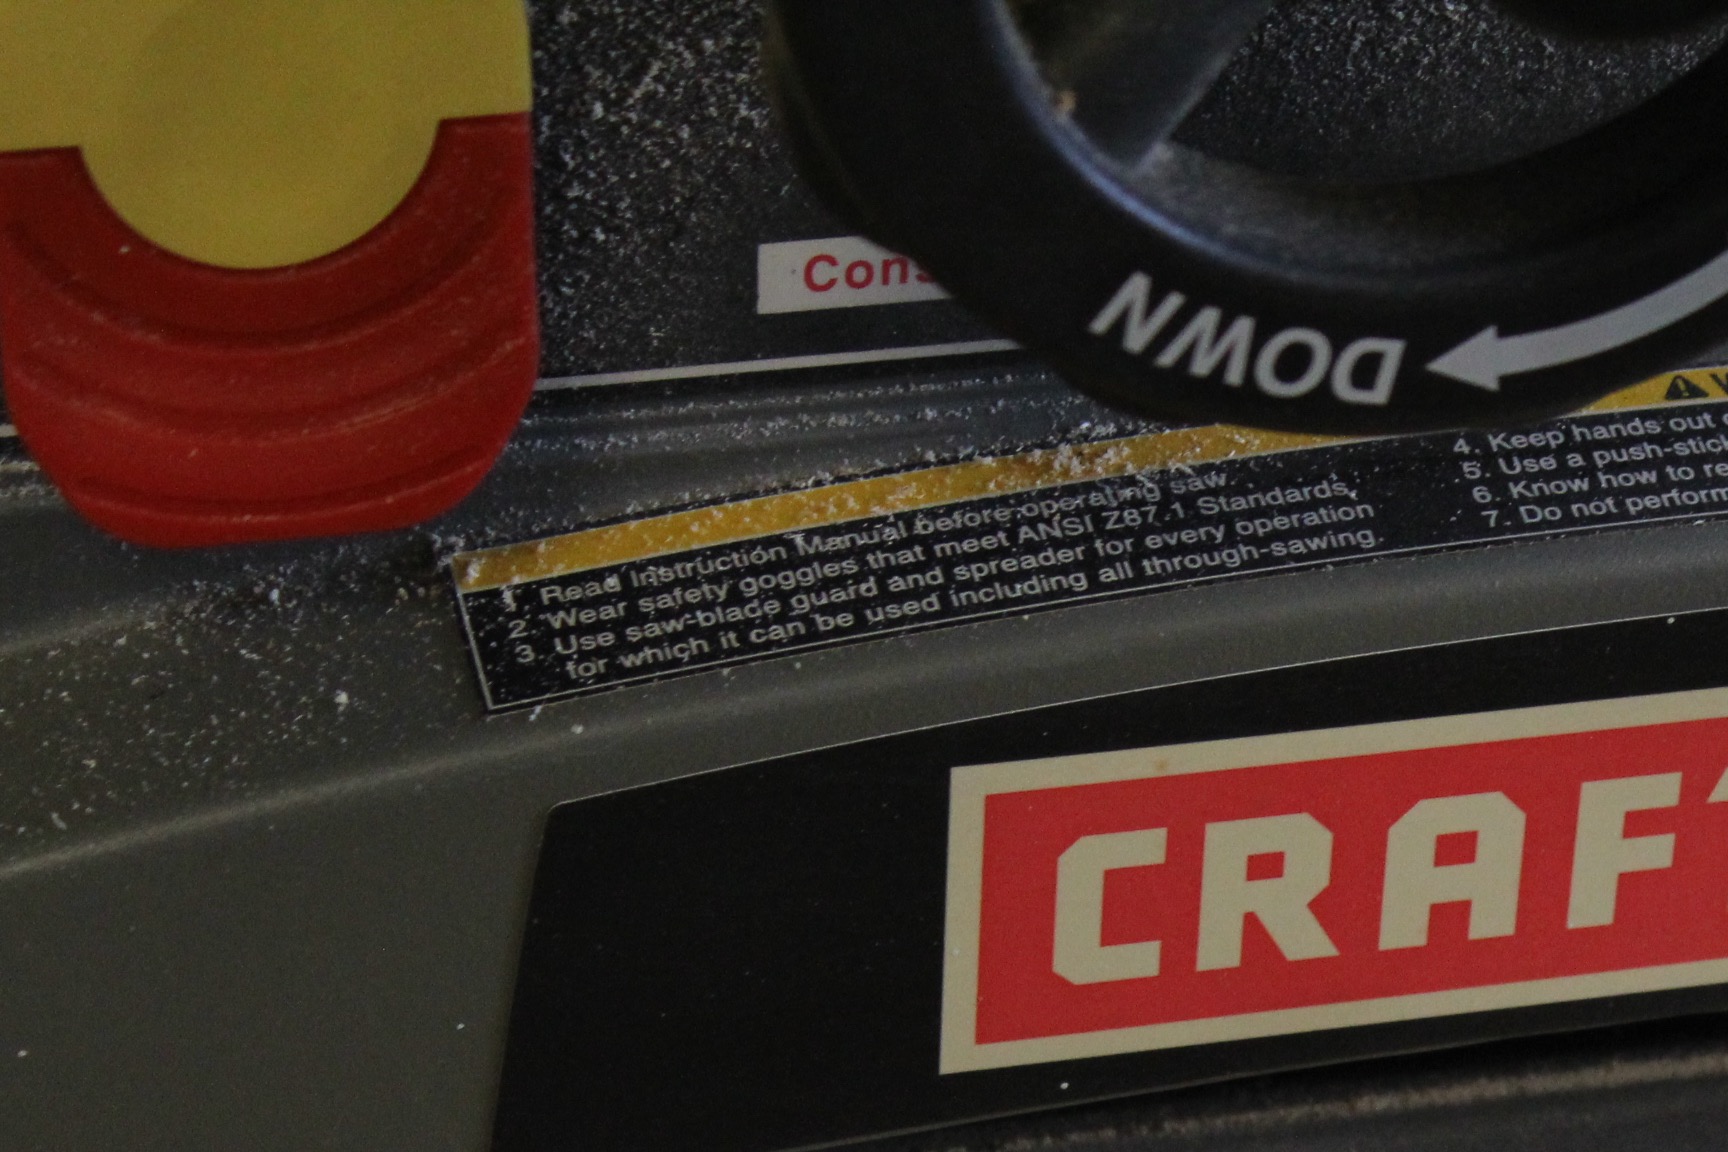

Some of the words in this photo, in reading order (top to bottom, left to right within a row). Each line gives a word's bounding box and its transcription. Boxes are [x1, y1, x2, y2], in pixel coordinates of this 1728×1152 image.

[1089, 270, 1406, 405] DOWN
[1453, 438, 1481, 455] 4.
[1488, 430, 1565, 453] Keep
[1571, 417, 1661, 442] hands
[1668, 414, 1716, 432] out
[1462, 461, 1491, 480] 5.
[1498, 454, 1558, 475] Use
[1567, 452, 1586, 468] a
[1472, 485, 1501, 503] 6.
[1508, 476, 1590, 499] Know
[1600, 469, 1657, 488] how
[1665, 464, 1696, 481] to
[540, 575, 621, 605] Read
[630, 544, 787, 588] Instruction
[798, 521, 907, 555] Manual
[913, 507, 1010, 534] before
[1021, 482, 1161, 518] operating
[1519, 504, 1562, 524] Do
[1571, 496, 1616, 517] not
[548, 601, 627, 630] Wear
[638, 583, 727, 612] safety
[739, 557, 858, 597] goggles
[866, 545, 926, 570] that
[933, 530, 1011, 557] meet
[1018, 514, 1094, 545] ANSI
[554, 631, 616, 655] Use
[626, 599, 781, 642] saw-blade
[791, 576, 878, 615] guard
[887, 566, 944, 592] and
[953, 545, 1086, 582] spreader
[1095, 536, 1135, 557] for
[1145, 523, 1225, 549] every
[1234, 503, 1375, 537] operation
[565, 657, 610, 679] for
[616, 637, 709, 669] which
[721, 631, 740, 649] it
[750, 623, 806, 644] can
[813, 612, 854, 632] be
[864, 593, 942, 625] used
[950, 572, 1088, 608] including
[1099, 561, 1134, 583] all
[1142, 527, 1385, 577] through-sawing.
